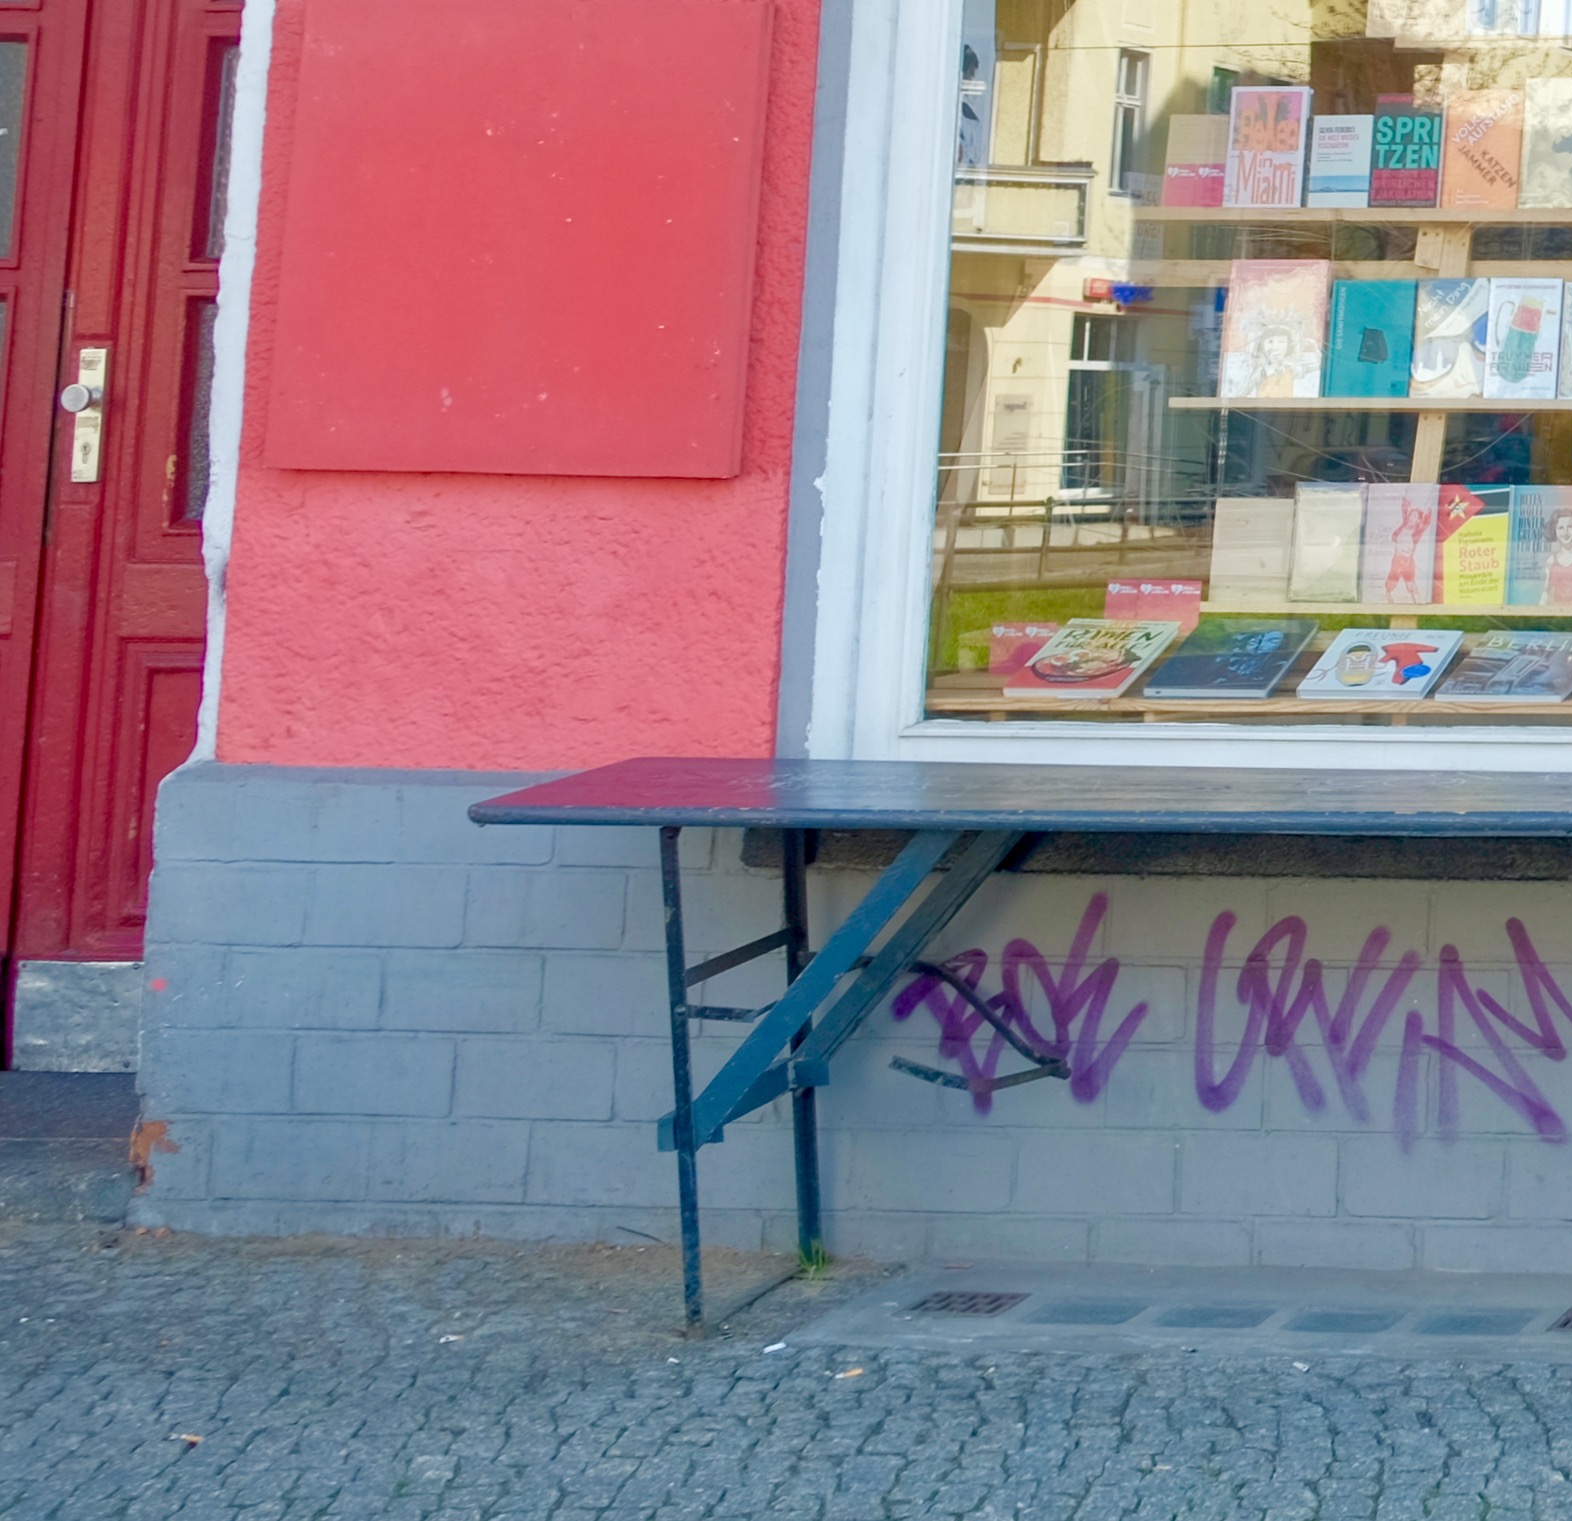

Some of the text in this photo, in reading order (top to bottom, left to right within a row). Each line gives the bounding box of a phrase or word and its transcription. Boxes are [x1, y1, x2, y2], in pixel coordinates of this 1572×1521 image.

[1376, 115, 1440, 144] SPRI
[1375, 144, 1438, 169] TZEN
[1458, 145, 1497, 187] JAMMER
[1480, 149, 1517, 188] KATZEN
[1235, 150, 1296, 205] Miami
[1458, 559, 1500, 573] Staub
[1459, 546, 1497, 559] Roter
[1062, 629, 1164, 642] RAMEN
